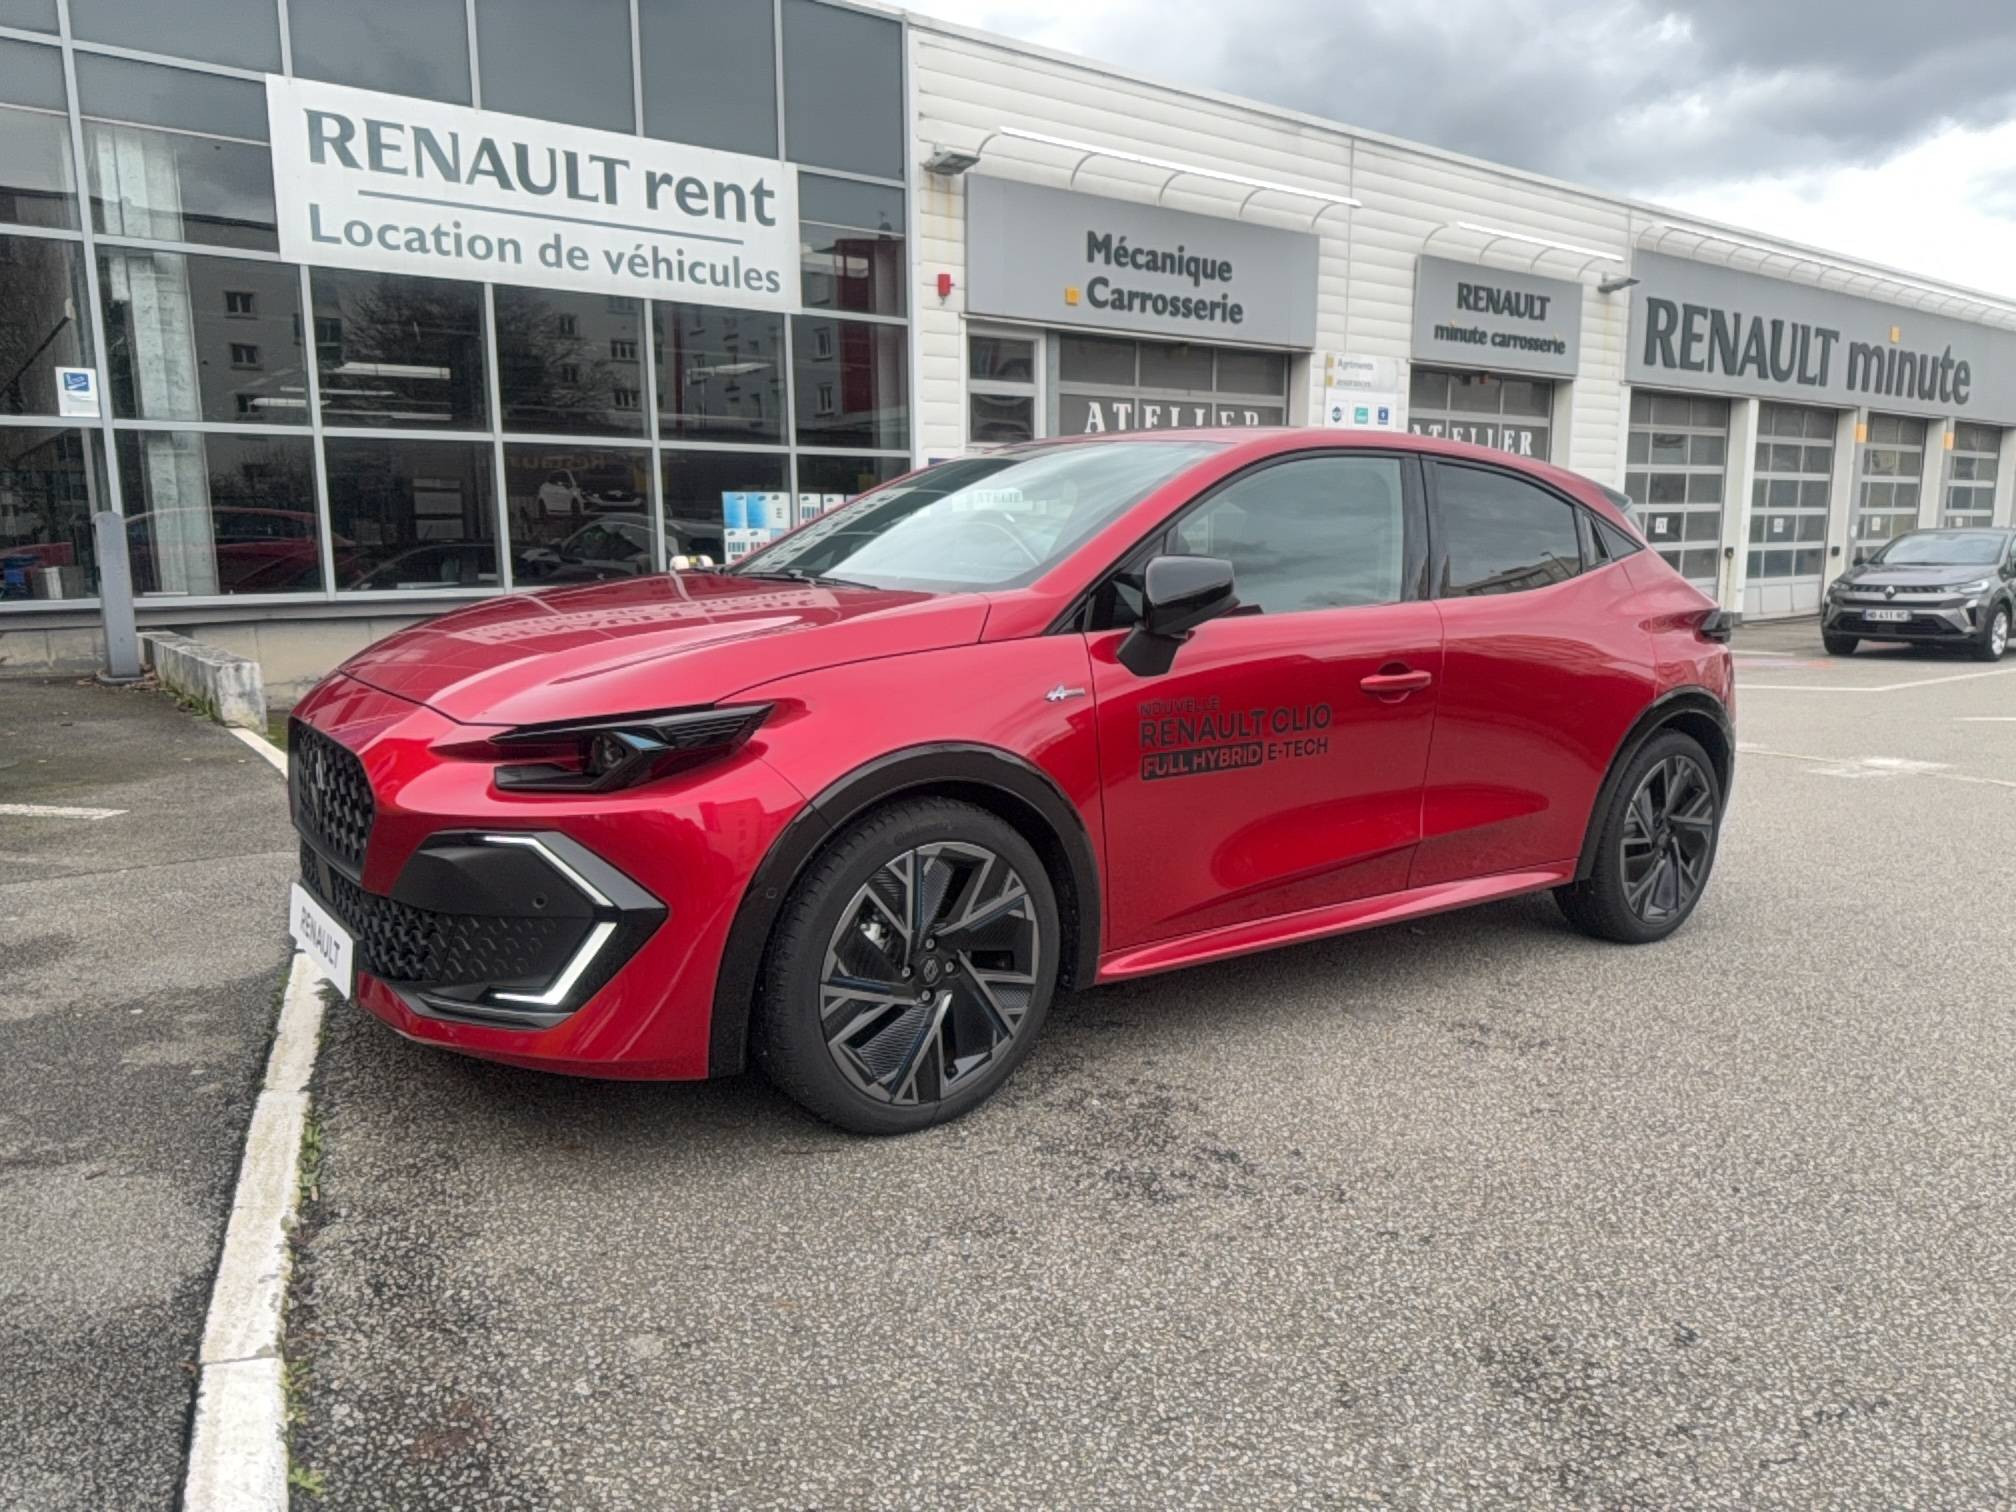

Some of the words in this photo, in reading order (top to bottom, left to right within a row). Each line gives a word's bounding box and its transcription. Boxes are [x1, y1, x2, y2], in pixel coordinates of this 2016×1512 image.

[303, 108, 631, 206] RENAULT
[645, 168, 776, 227] rent
[309, 202, 522, 264] Location
[538, 233, 590, 272] de
[603, 243, 781, 293] véhicules
[1086, 230, 1233, 288] Mécanique
[1086, 276, 1244, 324] Carrosserie
[1457, 281, 1551, 321] RENAULT
[1433, 321, 1488, 345] minute
[1490, 331, 1567, 355] carrosserie
[1643, 296, 1840, 387] RENAULT
[1846, 328, 1971, 405] minute
[1140, 696, 1220, 715] NOUVELLE
[1140, 711, 1266, 748] RENAULT
[1272, 703, 1332, 734] CLIO
[1143, 754, 1189, 778] FULL
[1193, 744, 1262, 771] HYBRID
[1268, 736, 1329, 761] E-TECH
[301, 905, 341, 969] RENAULT
